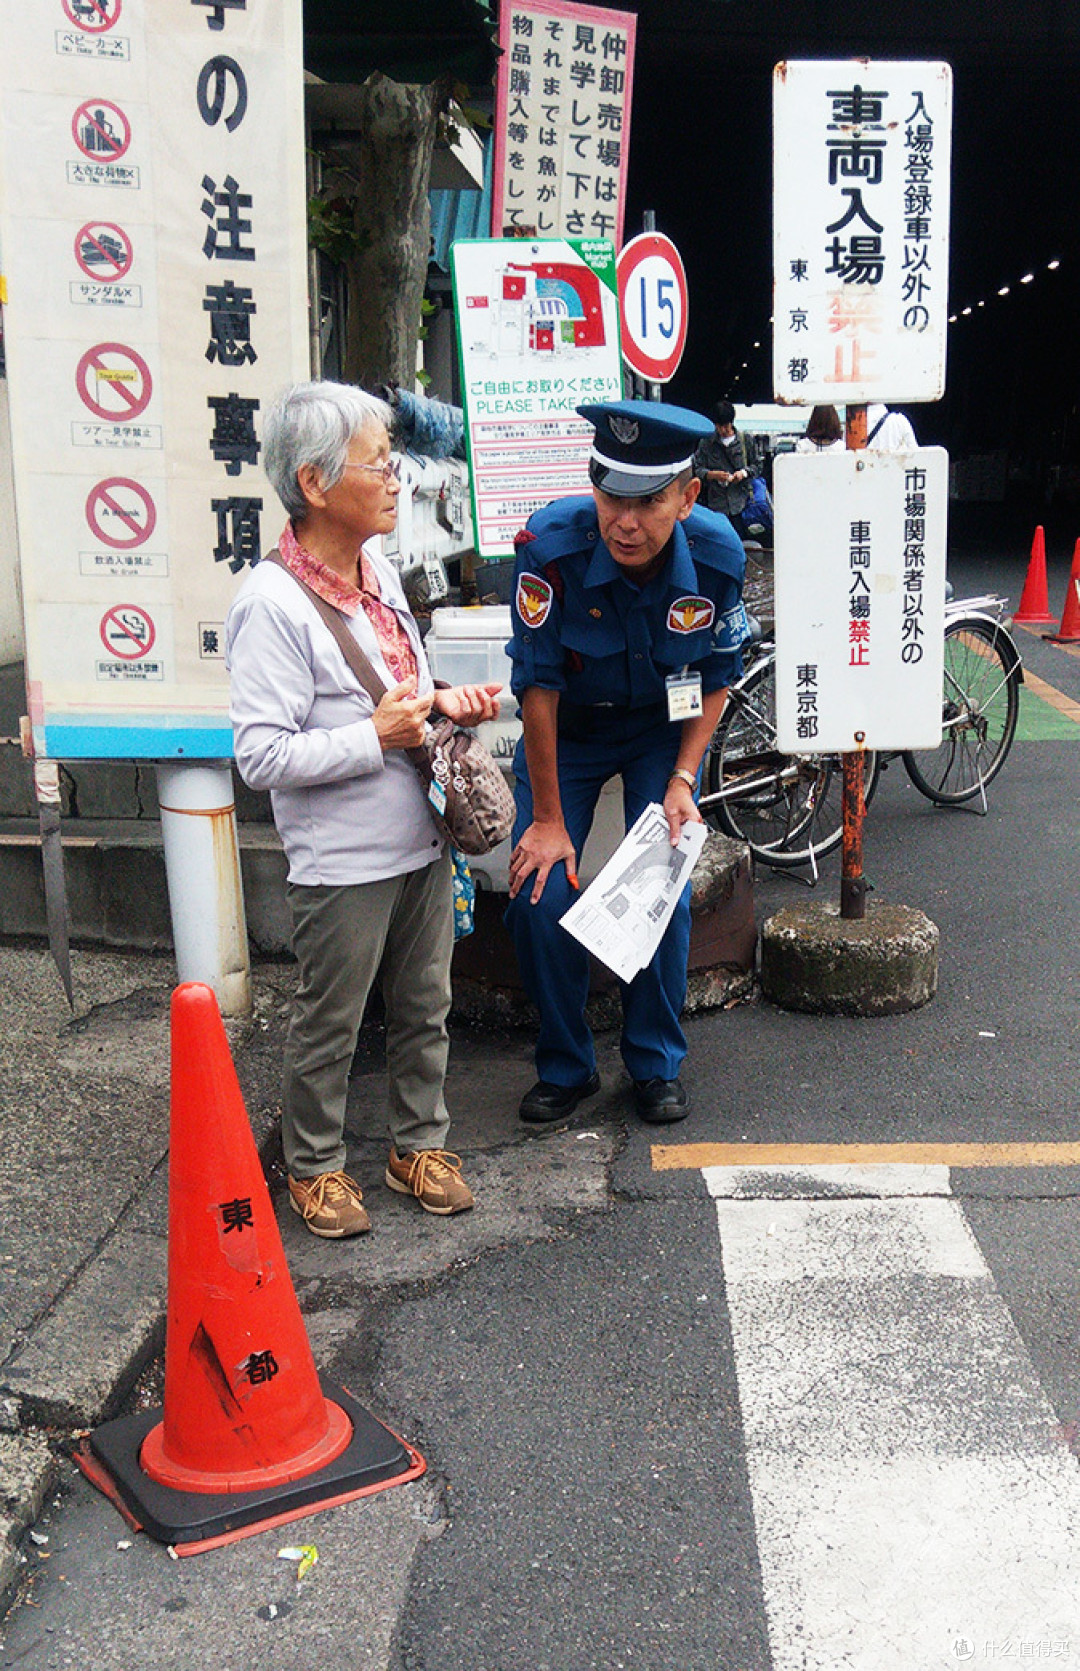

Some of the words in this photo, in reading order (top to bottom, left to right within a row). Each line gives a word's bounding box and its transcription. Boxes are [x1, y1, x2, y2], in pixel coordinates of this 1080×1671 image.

[505, 15, 533, 226] 物品購入等をして
[536, 20, 564, 230] それまでは魚がし
[566, 24, 597, 235] 見学して下さ
[590, 31, 626, 237] 仲卸売場は午
[901, 90, 934, 333] 入場登録車以外の
[470, 377, 620, 396] ご自由にお取りください
[640, 276, 674, 339] 15
[788, 258, 809, 382] 東京都
[476, 399, 534, 415] PLEASE
[539, 397, 577, 412] TAKE
[848, 519, 871, 666] 車両入場禁止
[901, 466, 927, 664] 市場関係者以外の
[795, 663, 819, 739] 東京都
